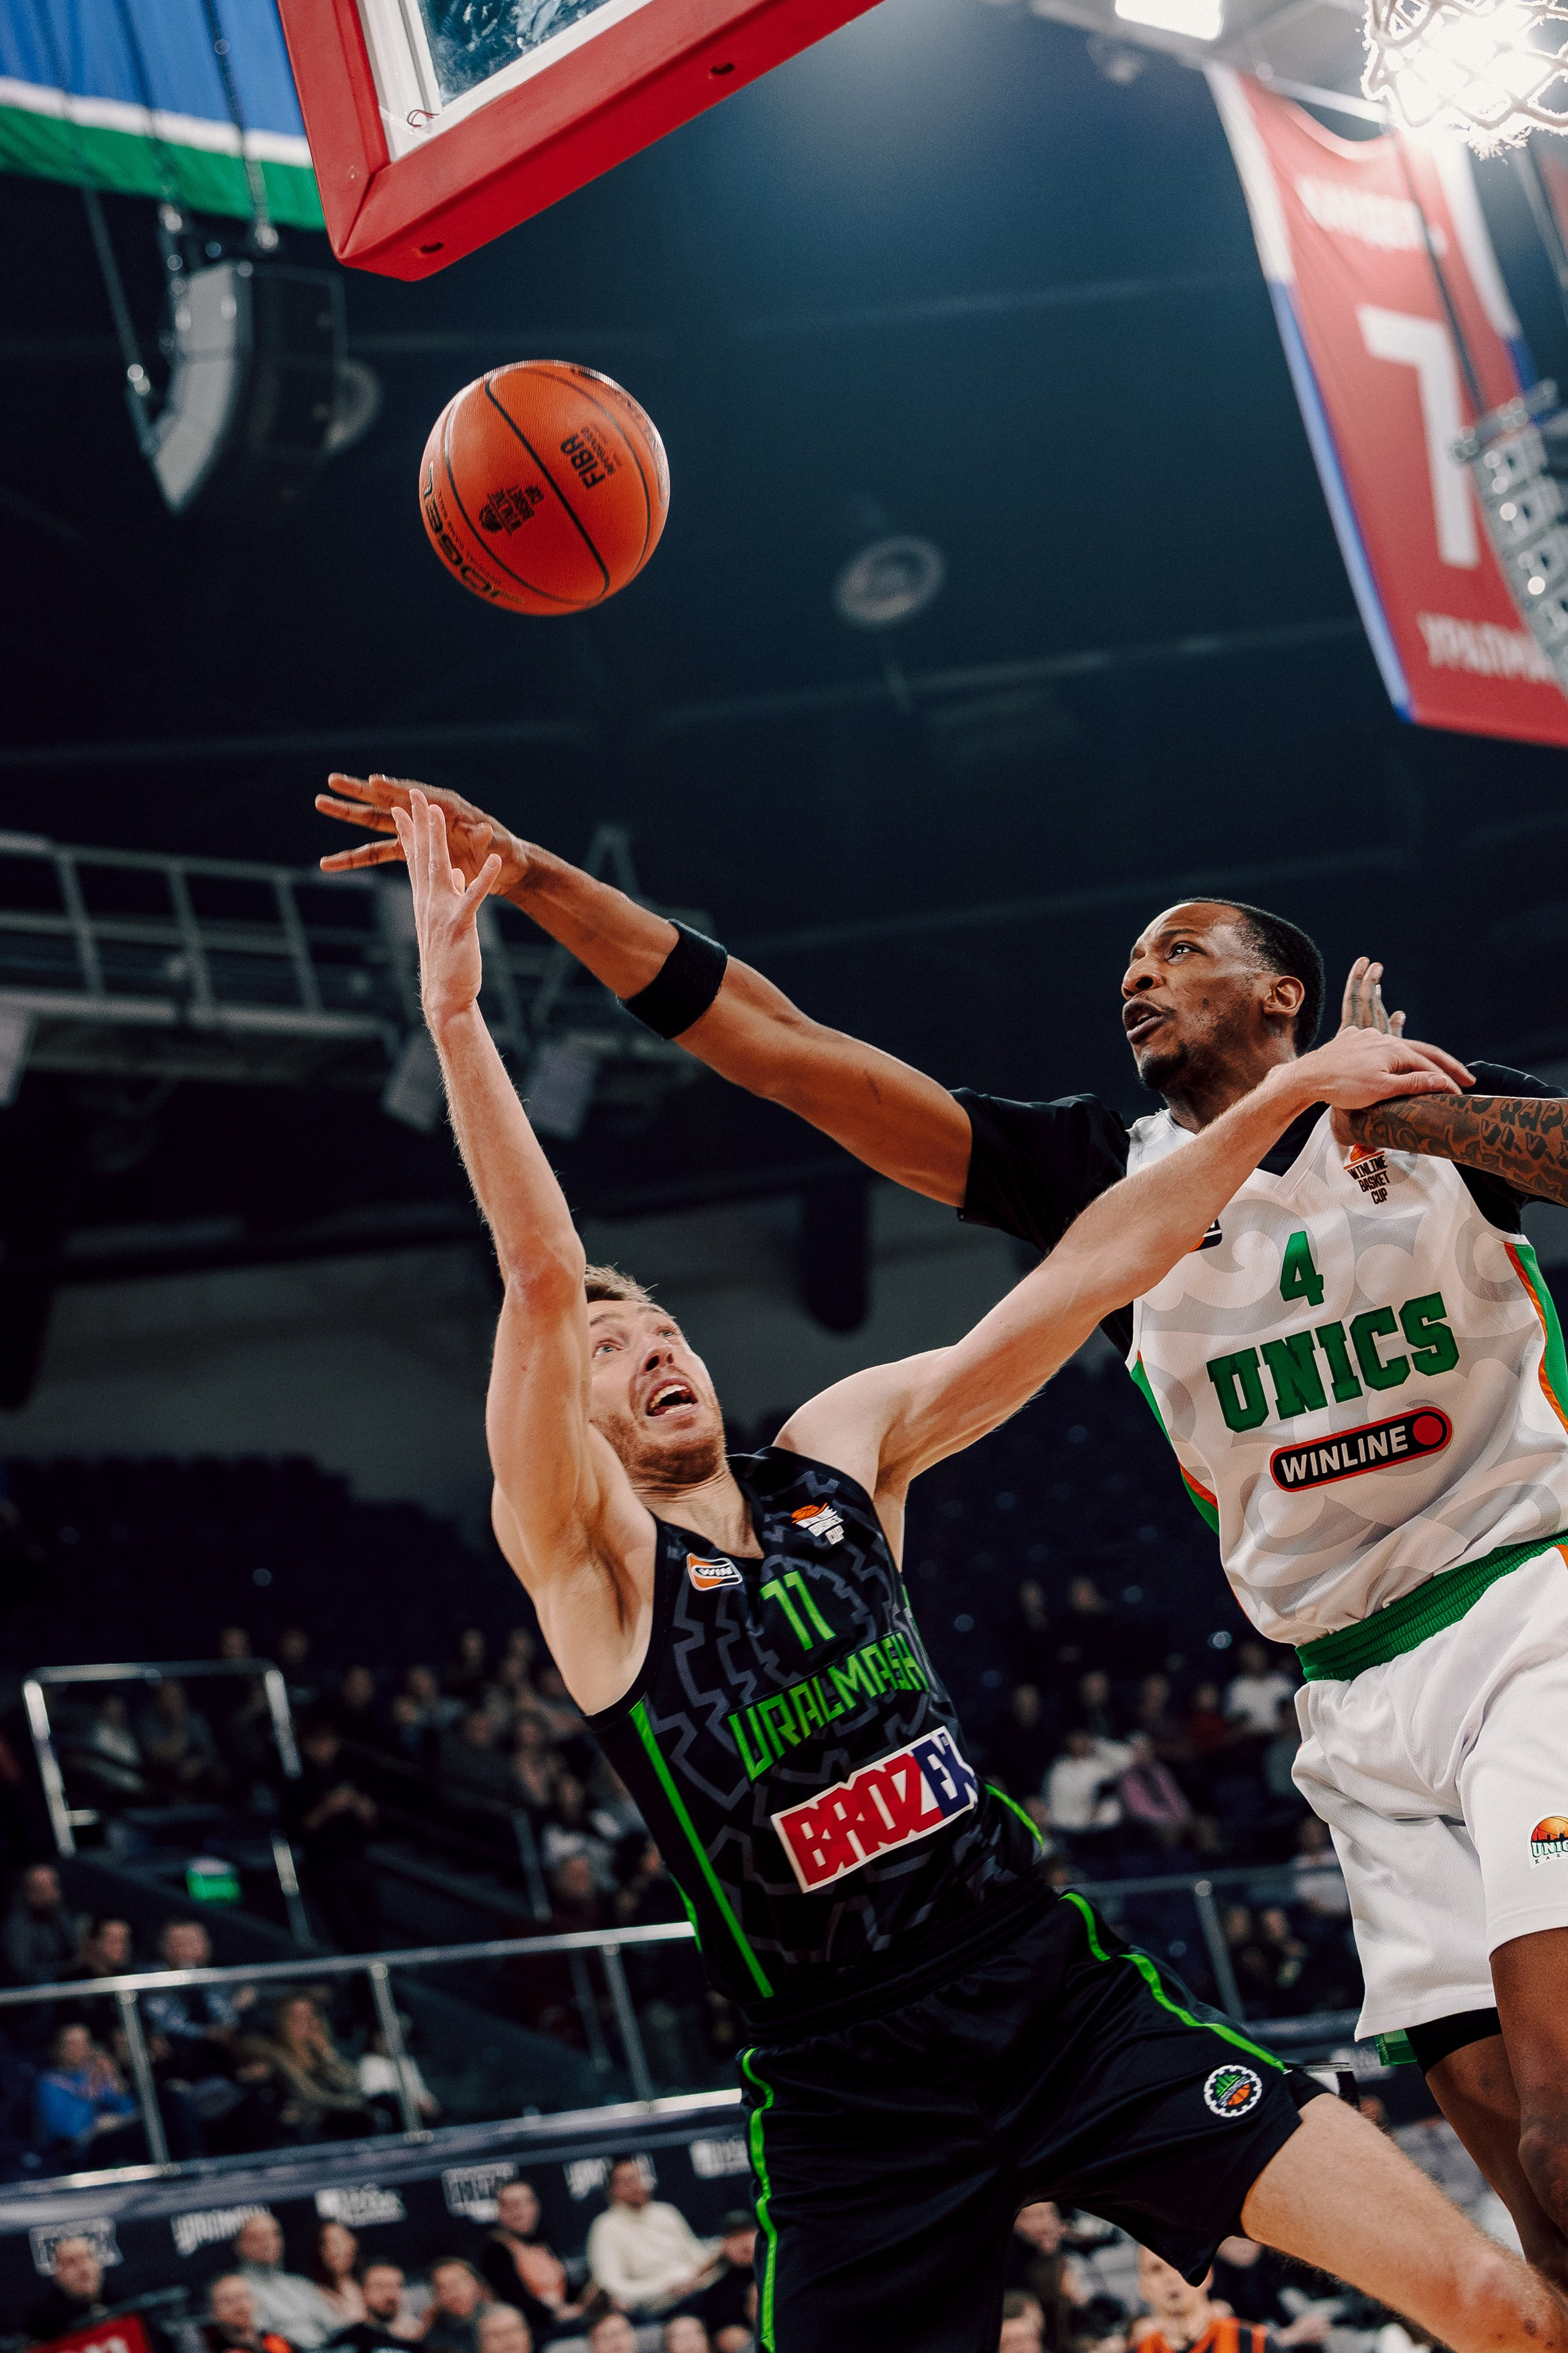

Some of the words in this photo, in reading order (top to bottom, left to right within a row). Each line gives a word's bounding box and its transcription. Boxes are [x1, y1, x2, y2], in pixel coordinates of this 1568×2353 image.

[560, 434, 606, 489] FIBA
[1355, 304, 1480, 568] 7
[1348, 1155, 1388, 1180] WINLINE
[1358, 1171, 1390, 1193] BASKET
[1371, 1187, 1388, 1204] CUP
[1280, 1231, 1324, 1307] 4
[1206, 1291, 1460, 1433] UNICS
[1281, 1425, 1409, 1482] WINLINE
[760, 1571, 836, 1650] 11
[728, 1632, 930, 1781] URALMASH
[779, 1730, 975, 1886] BROZEX
[1534, 1854, 1568, 1864] KAZ
